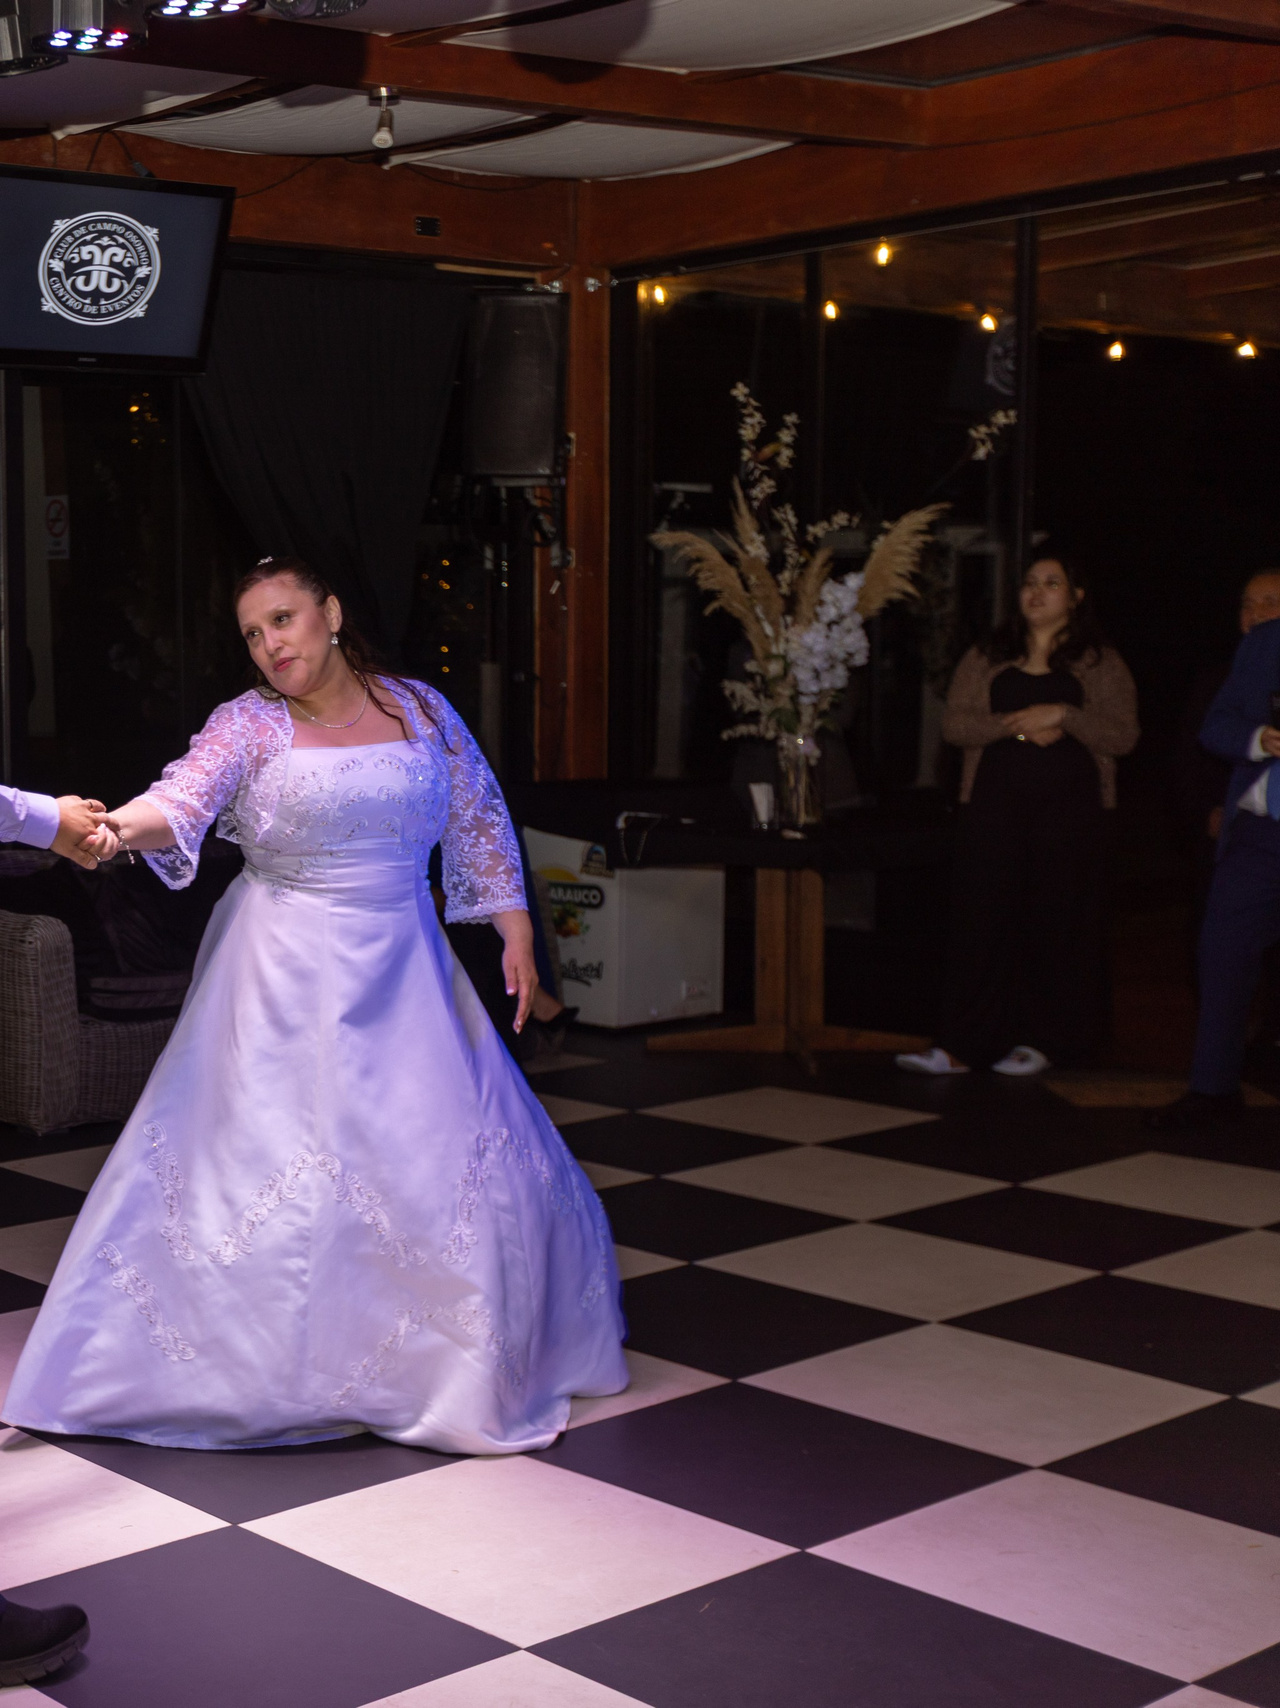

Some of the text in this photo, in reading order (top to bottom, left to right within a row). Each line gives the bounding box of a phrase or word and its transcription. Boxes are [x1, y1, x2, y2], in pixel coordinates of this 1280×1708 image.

[52, 223, 150, 265] CLUB DE CAMPO OSORNO
[49, 277, 145, 314] CENTRO DE EVENTOS
[550, 887, 601, 905] ARAUCO
